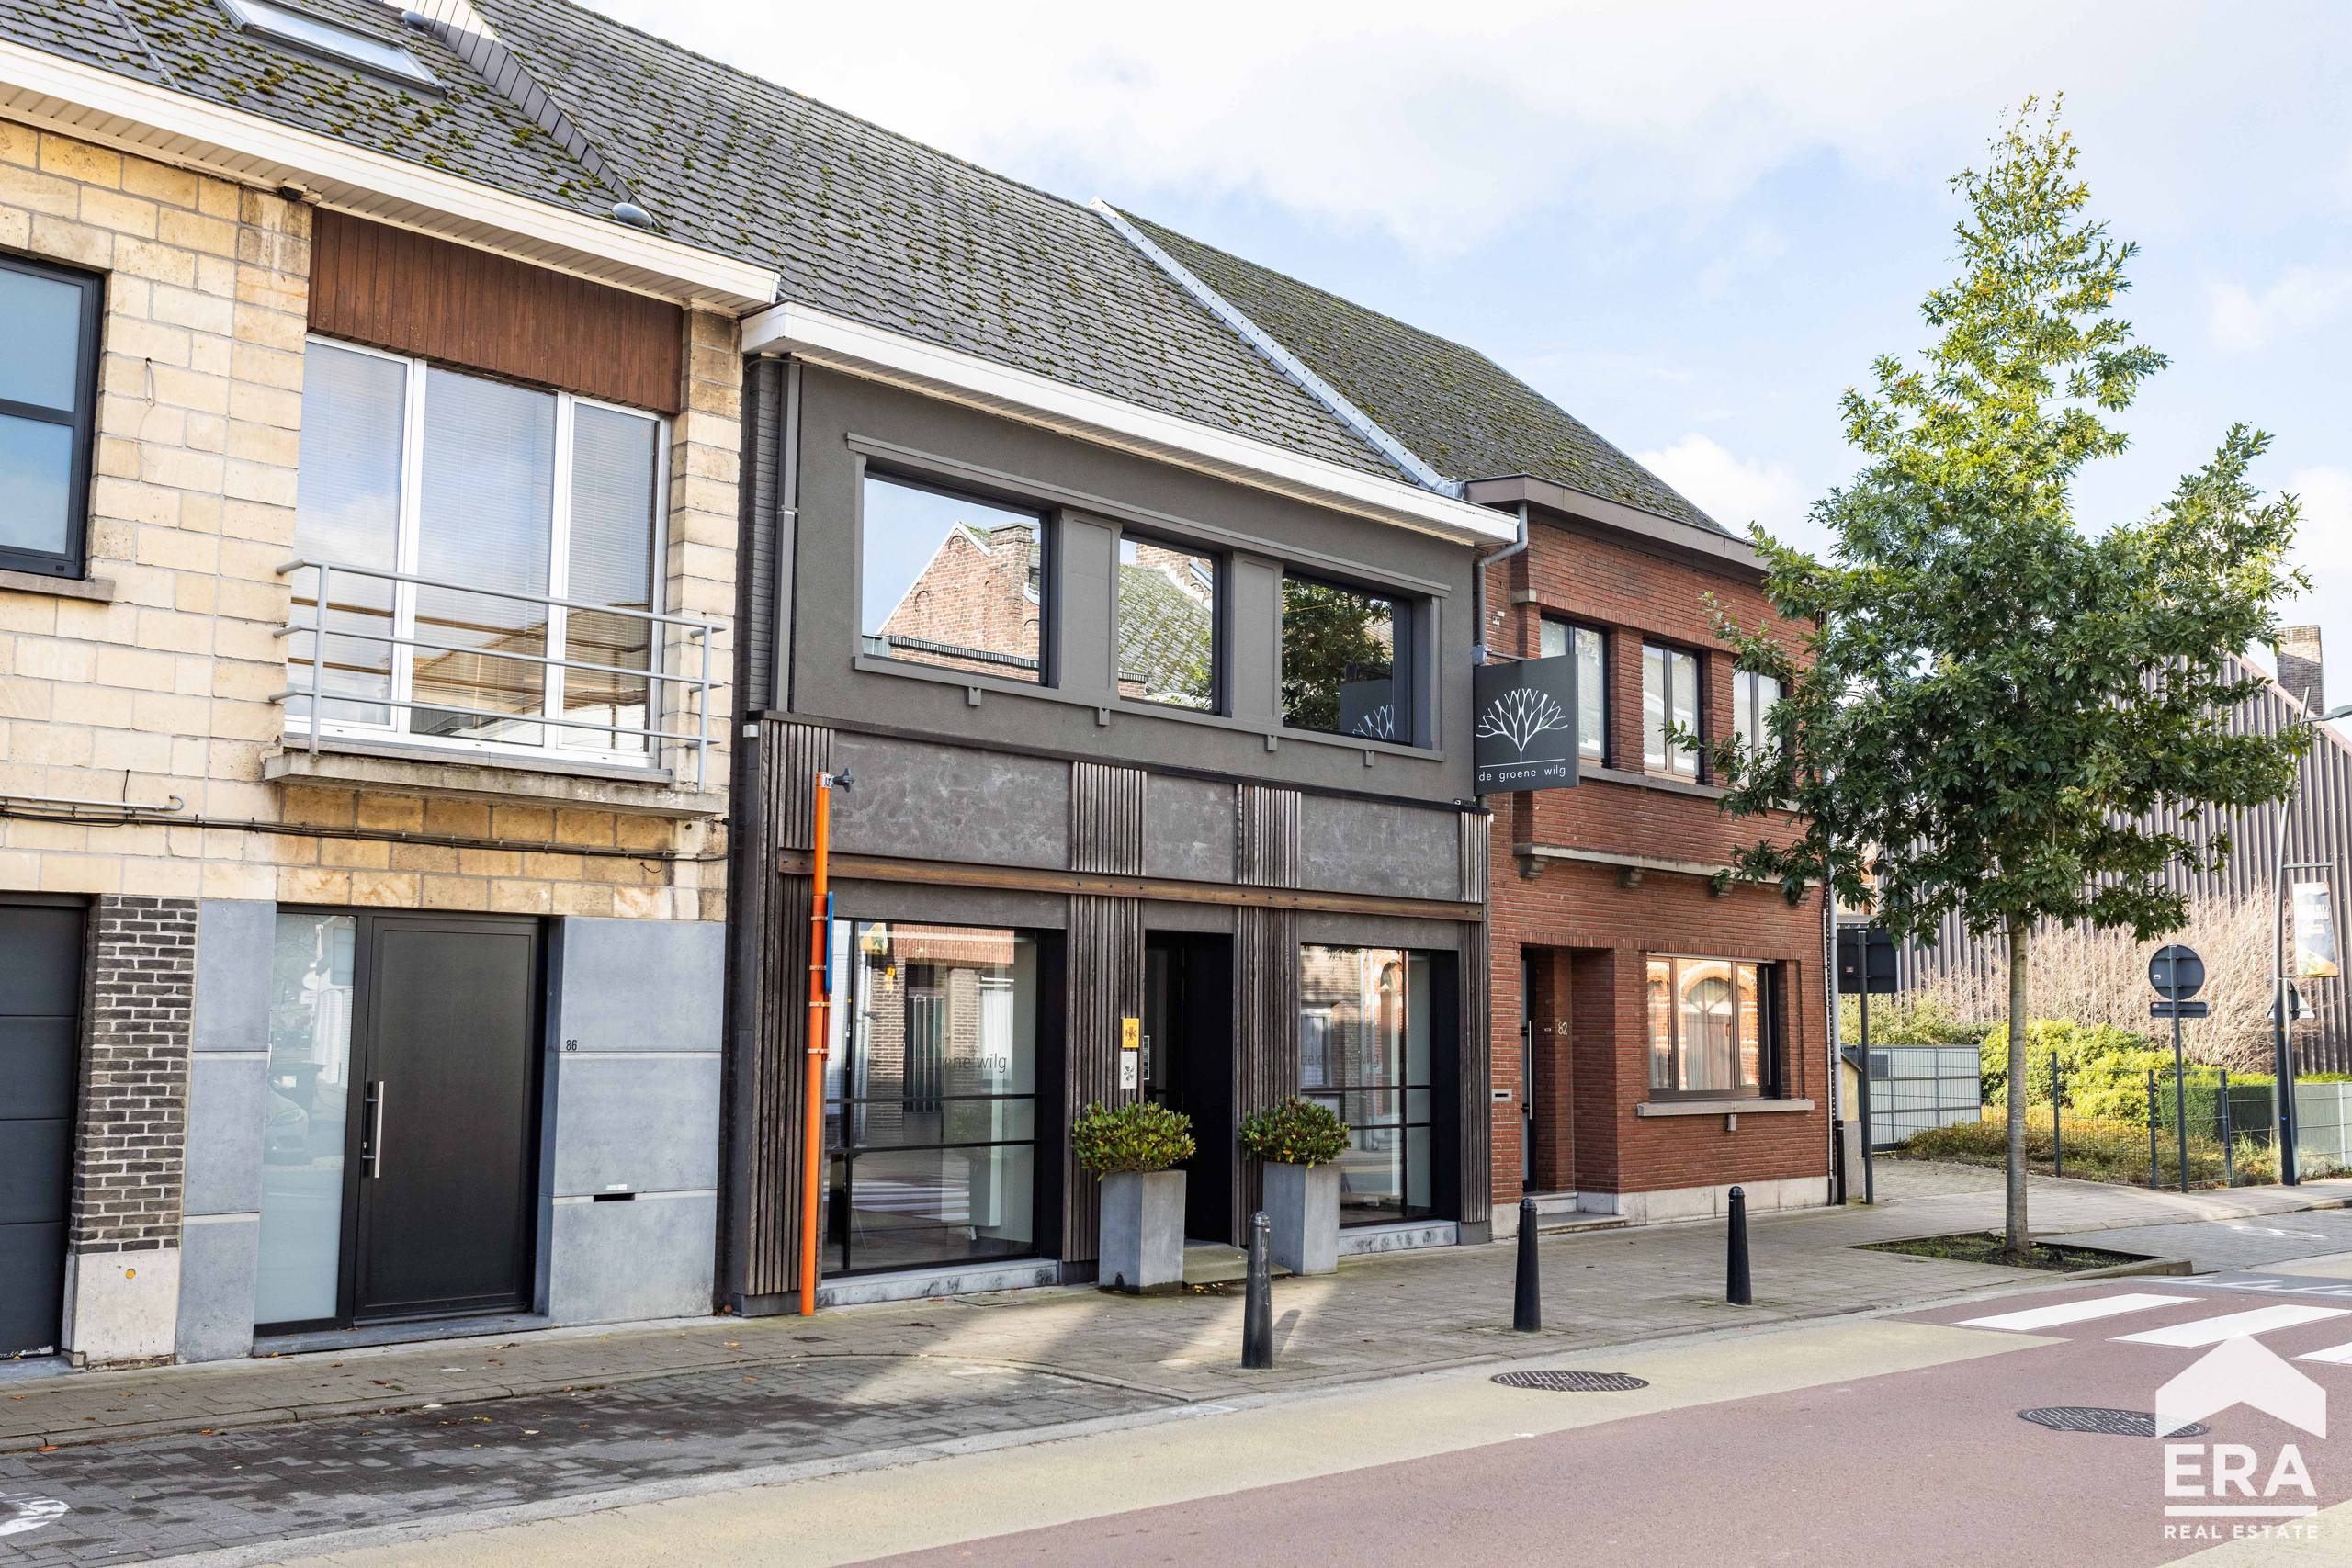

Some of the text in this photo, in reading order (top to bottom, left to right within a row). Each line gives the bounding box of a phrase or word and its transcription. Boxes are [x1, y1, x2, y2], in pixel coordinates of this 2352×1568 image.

[1478, 764, 1566, 783] de groene wilg
[1557, 1021, 1568, 1035] 82
[566, 1039, 578, 1051] 86
[977, 1052, 1007, 1073] wilg
